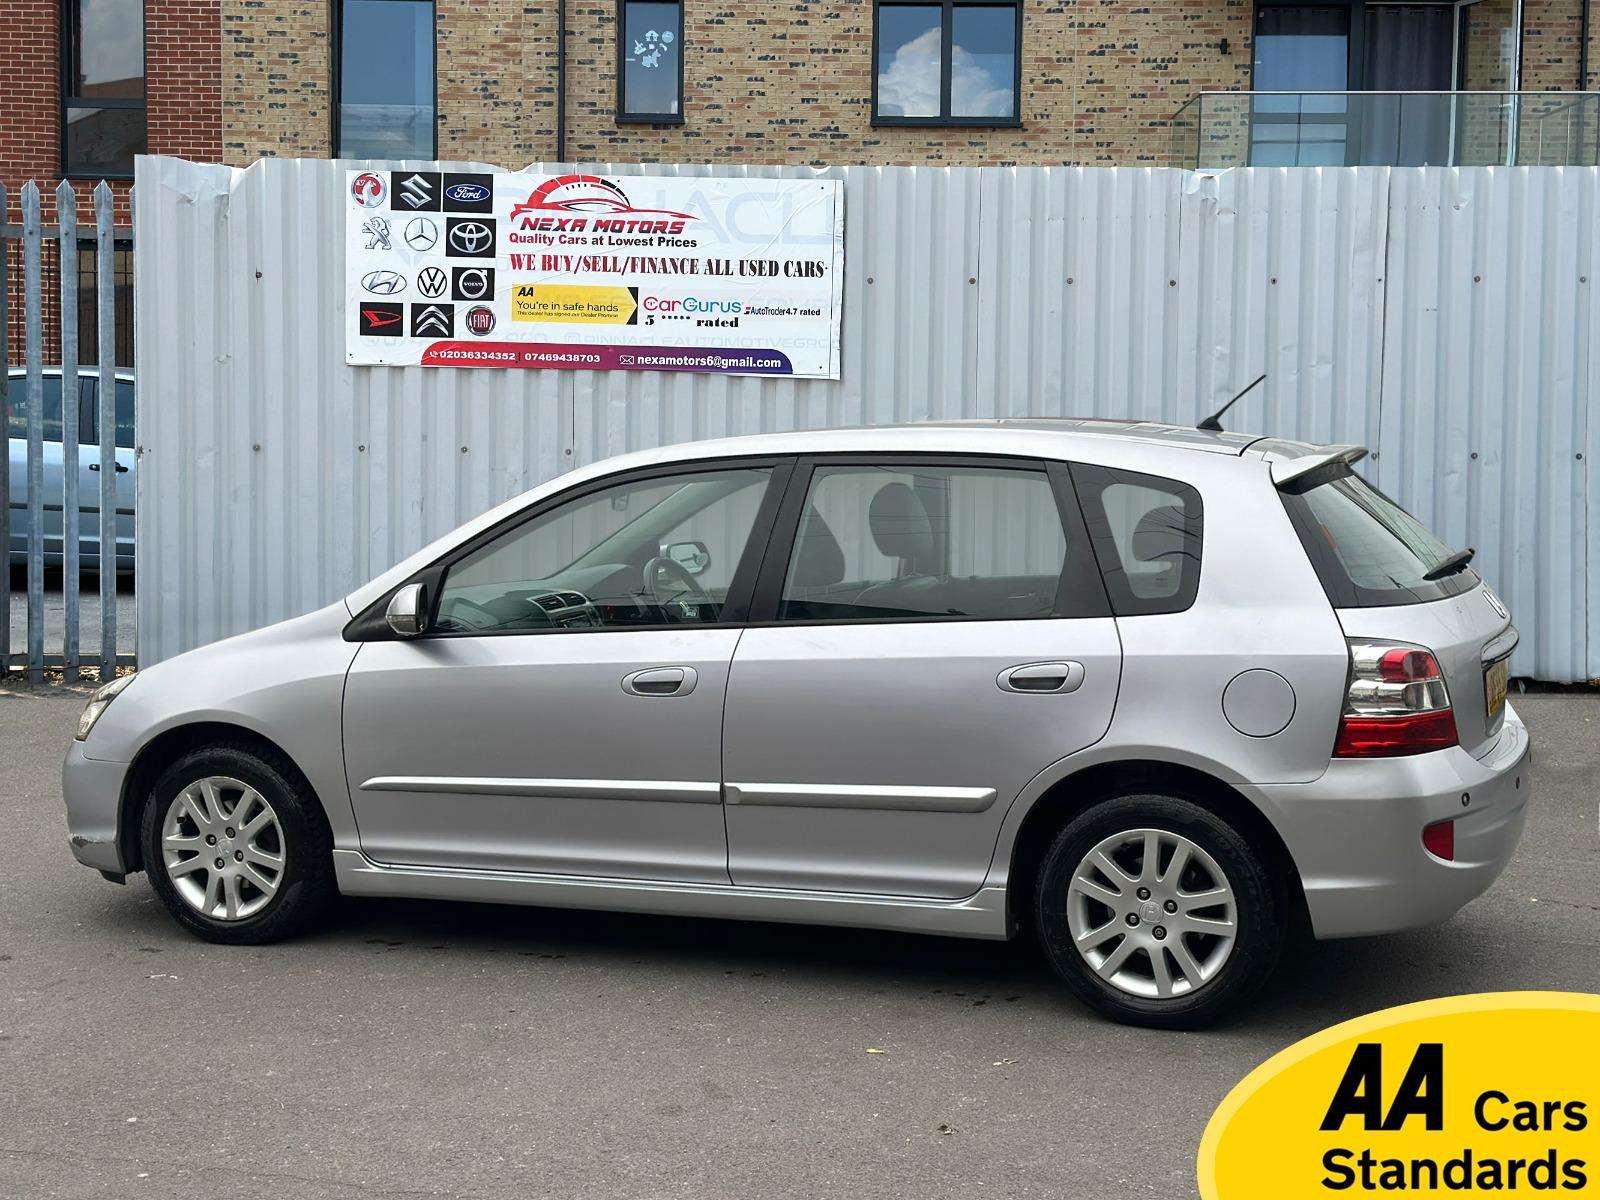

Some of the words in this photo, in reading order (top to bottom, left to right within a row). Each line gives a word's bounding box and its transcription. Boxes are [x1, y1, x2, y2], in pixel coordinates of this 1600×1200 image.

[454, 186, 482, 199] Ford
[519, 217, 588, 233] NEXA
[592, 219, 686, 235] MOTORS
[509, 233, 554, 246] Quality
[558, 234, 588, 245] Cars
[591, 236, 604, 246] at
[608, 236, 654, 247] Lowest
[657, 236, 697, 248] Prices
[509, 254, 536, 271] WE
[541, 254, 700, 276] BUY/SELL/FINANCE
[703, 258, 735, 276] ALL
[738, 259, 780, 277] USED
[783, 260, 826, 278] CARS
[517, 286, 534, 297] AA
[517, 301, 549, 310] You're
[551, 302, 560, 310] in
[562, 302, 584, 311] safe
[587, 303, 619, 312] hands
[643, 297, 742, 313] CarGurus
[799, 308, 821, 316] rated
[473, 314, 490, 328] FIAT
[645, 315, 655, 326] 5
[696, 317, 739, 328] rated
[439, 351, 516, 361] 02036334352
[524, 352, 601, 363] 07469438703
[637, 354, 782, 369] nexamotors6@gmail.com
